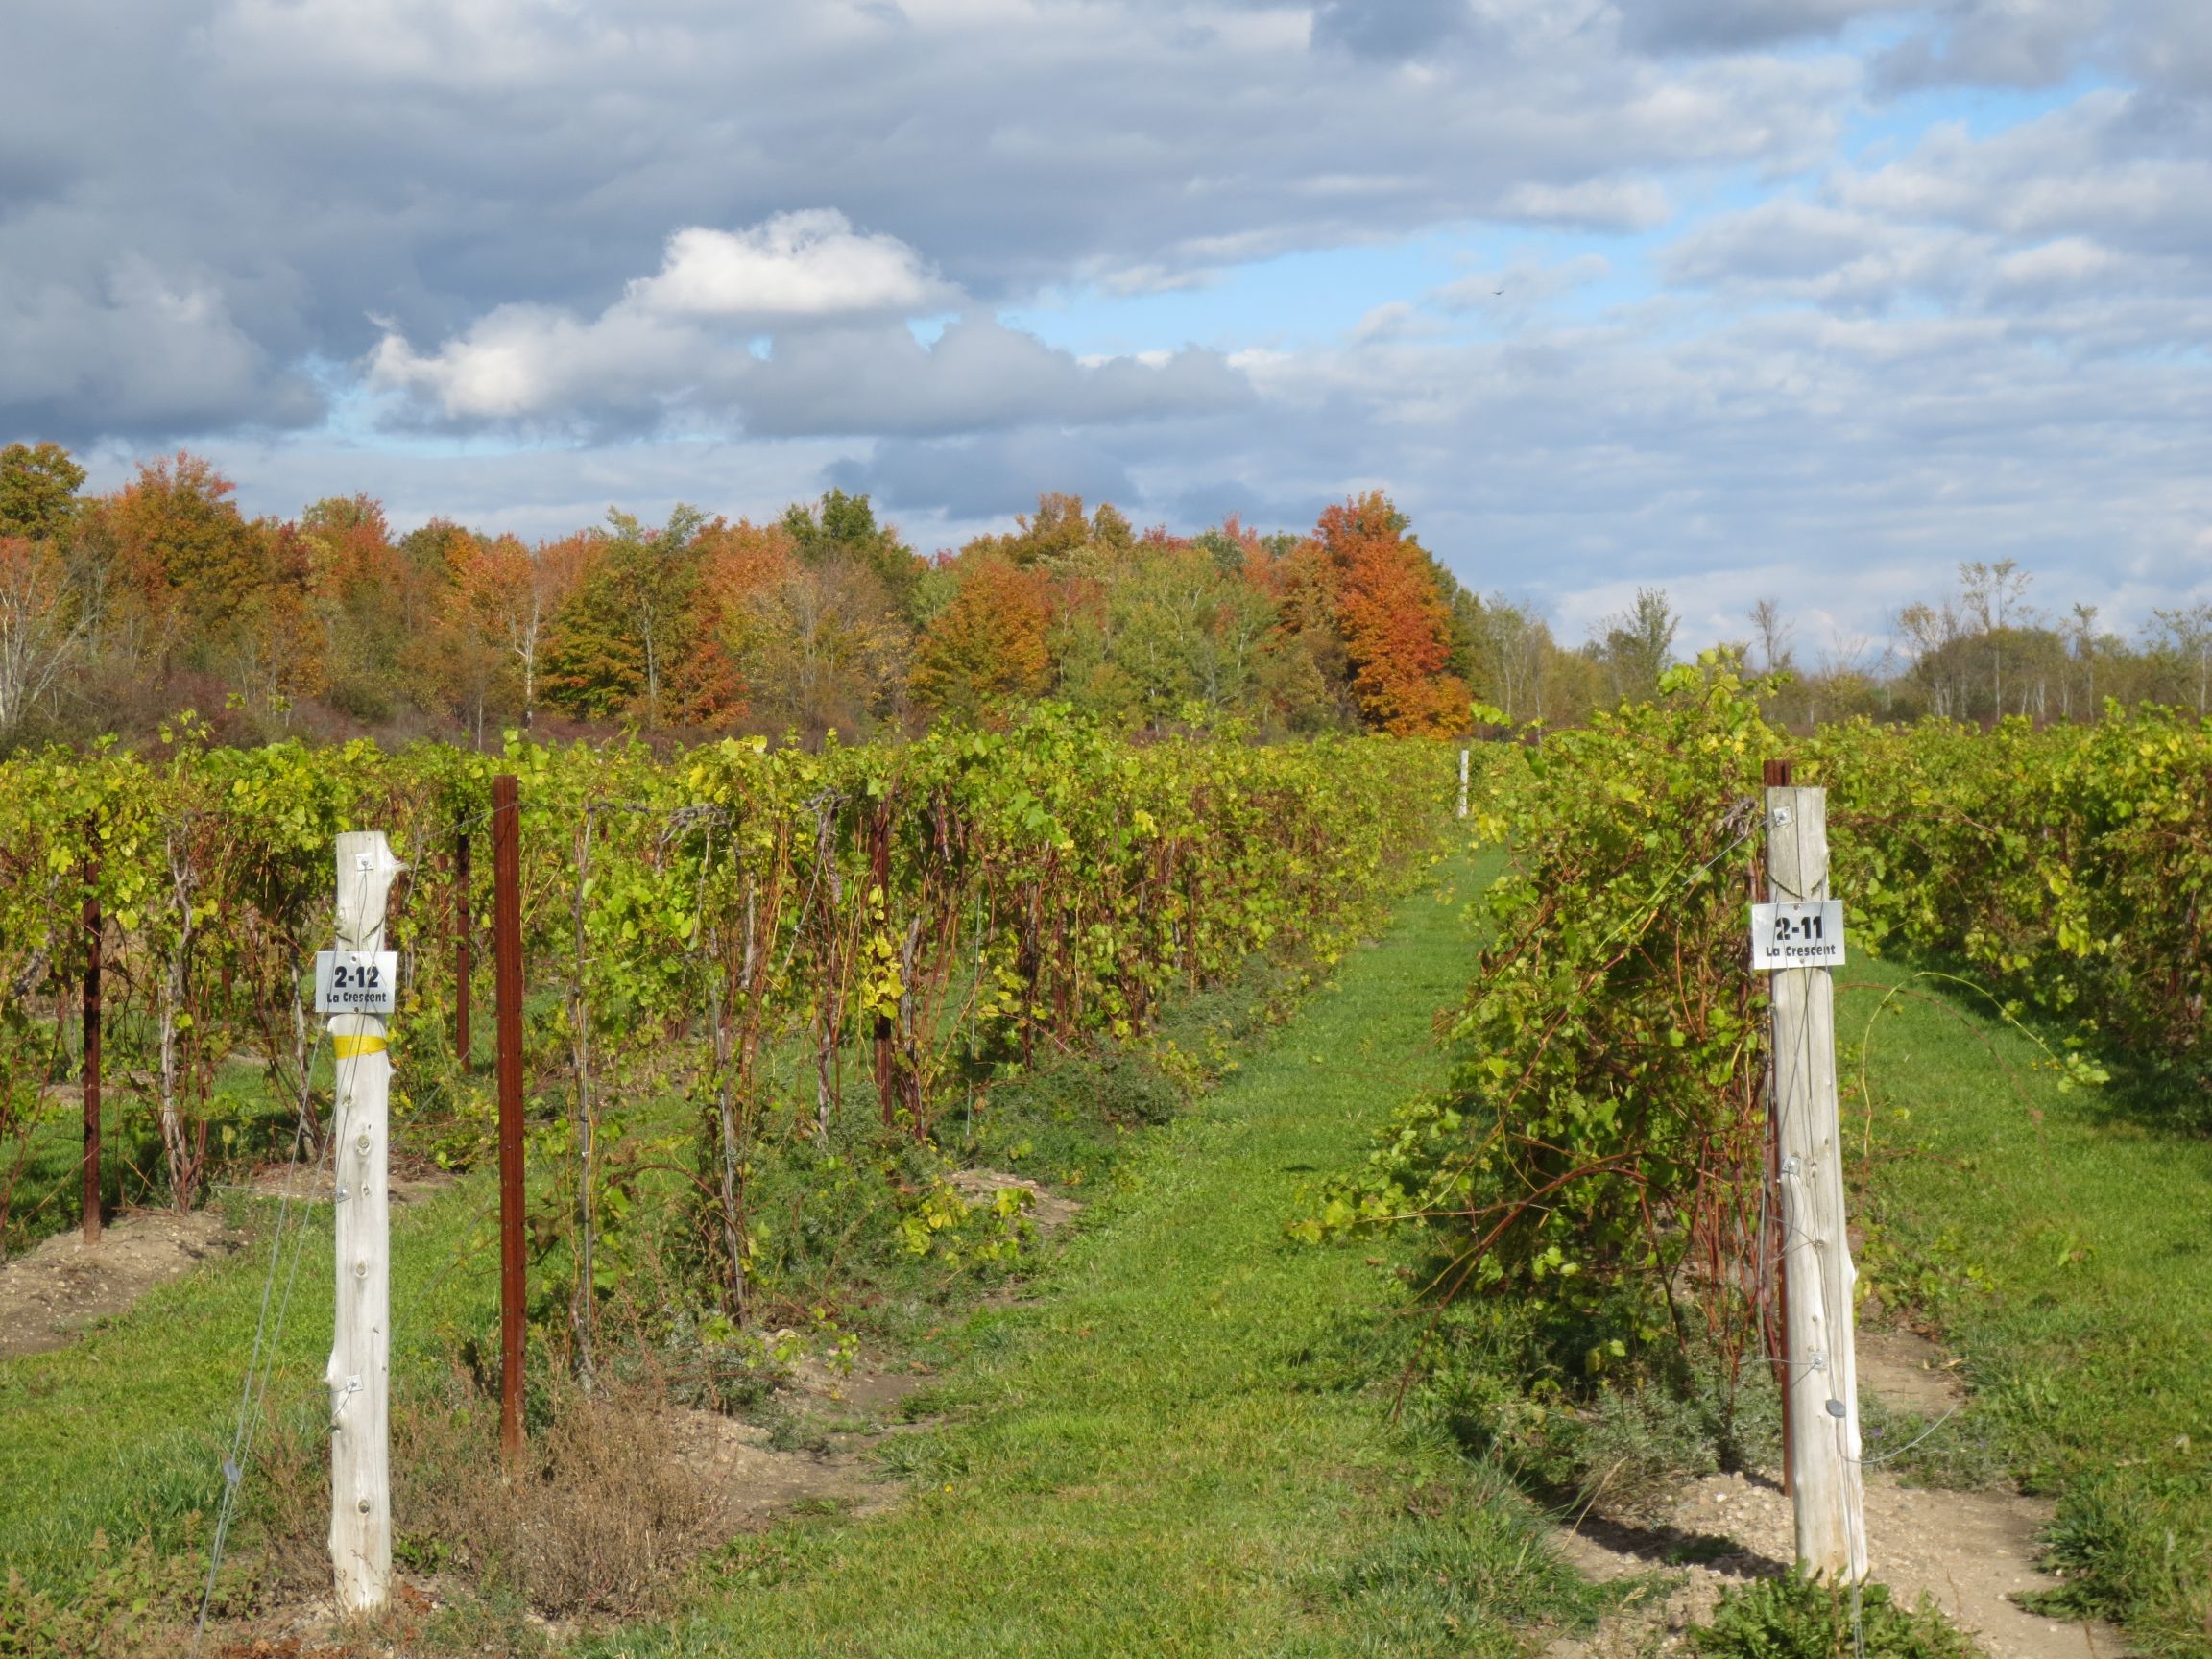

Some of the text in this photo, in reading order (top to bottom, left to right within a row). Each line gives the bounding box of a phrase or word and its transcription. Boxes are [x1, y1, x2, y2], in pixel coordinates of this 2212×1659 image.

[1775, 915, 1823, 941] 2-11
[1766, 944, 1836, 957] La Crescent
[334, 965, 379, 988] 2-12
[326, 992, 387, 1003] La Crescent
